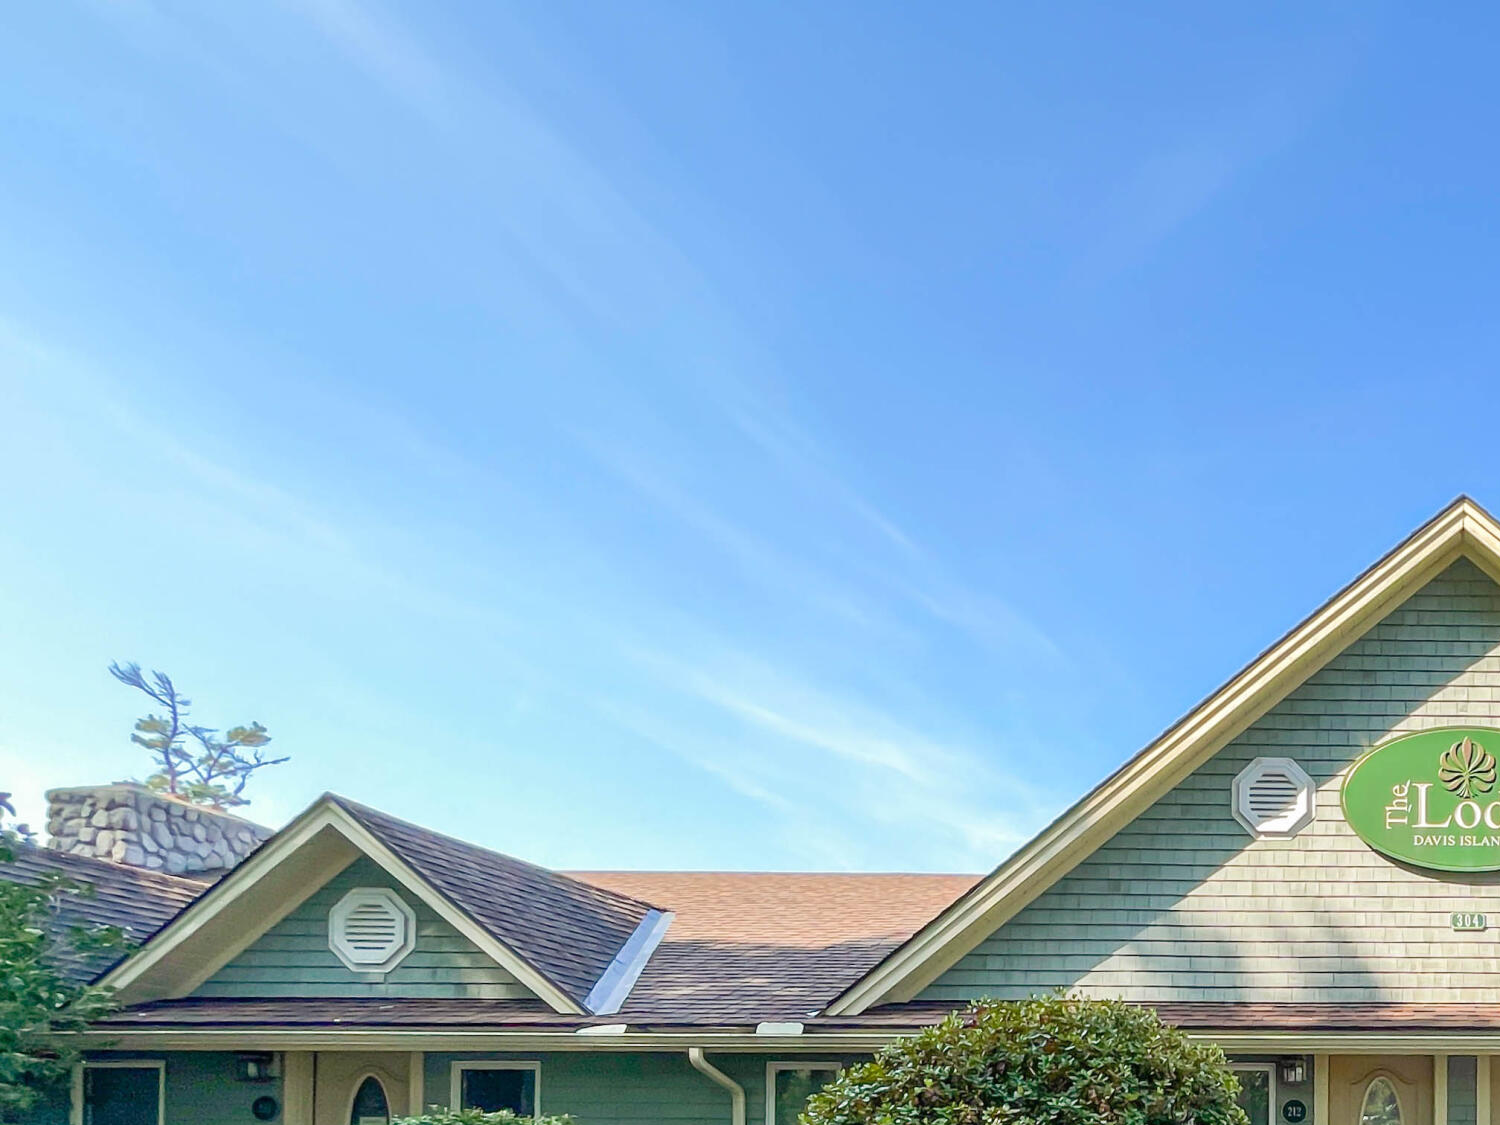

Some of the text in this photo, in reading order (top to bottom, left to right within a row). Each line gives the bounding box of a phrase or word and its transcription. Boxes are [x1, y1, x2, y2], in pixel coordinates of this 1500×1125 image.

[1385, 779, 1411, 829] The
[1413, 834, 1456, 847] DAVIS
[1456, 913, 1479, 927] 304
[1287, 1106, 1302, 1117] 212
